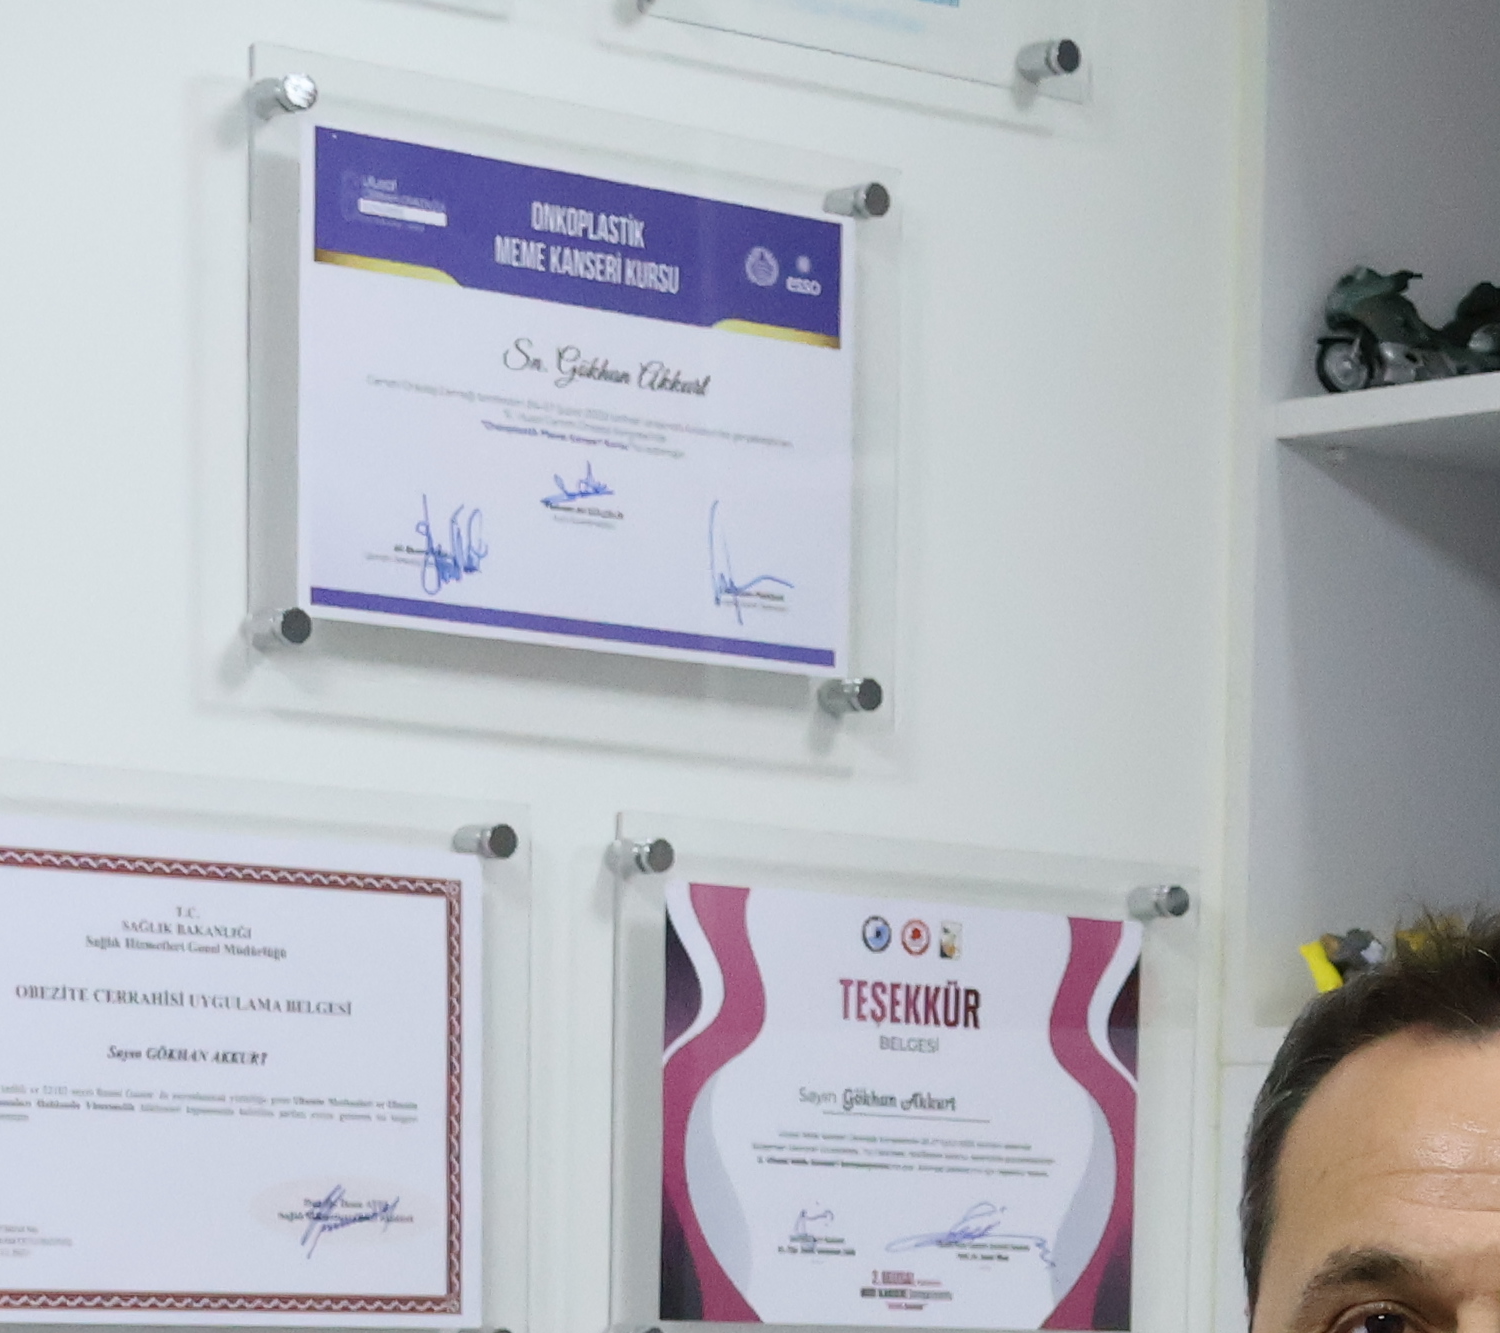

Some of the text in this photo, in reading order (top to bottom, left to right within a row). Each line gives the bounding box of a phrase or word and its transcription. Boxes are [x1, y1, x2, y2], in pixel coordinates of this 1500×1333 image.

[495, 235, 681, 295] MEME KANSERİ KURSU
[554, 344, 631, 388] Gökhan
[16, 984, 89, 1002] OBEZİTE
[93, 988, 185, 1007] CERRAHİSİ
[189, 994, 281, 1013] UYGULAMA
[840, 978, 982, 1030] TEŞEKKÜR
[146, 1046, 208, 1064] GÖKHAN
[879, 1035, 940, 1054] BELGESİ
[842, 1087, 897, 1111] Gökhan
